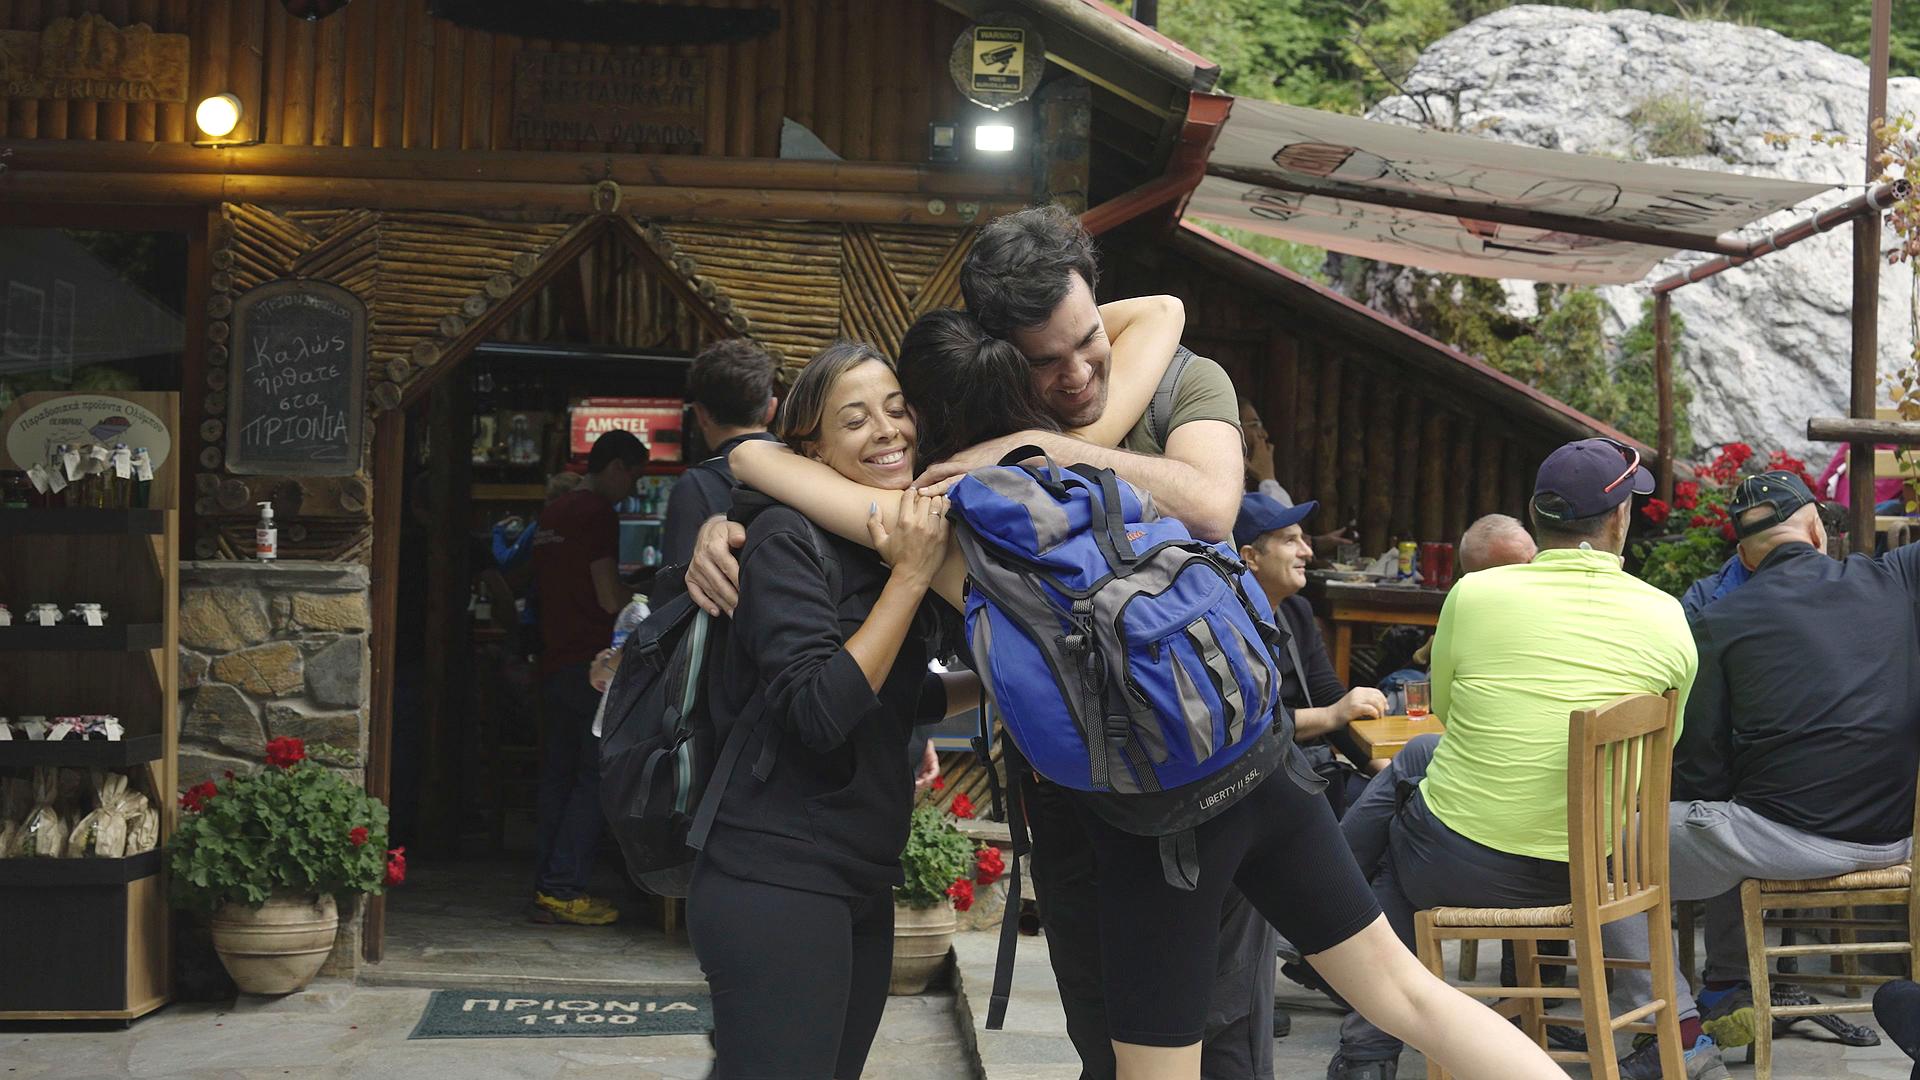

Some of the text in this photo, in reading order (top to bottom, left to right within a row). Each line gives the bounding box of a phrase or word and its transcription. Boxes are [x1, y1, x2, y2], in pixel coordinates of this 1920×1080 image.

[981, 31, 1019, 40] WARNING
[246, 335, 345, 372] Καλώς
[253, 365, 341, 395] ήρθατε
[279, 392, 325, 411] στα
[19, 402, 80, 431] Παραδοσιακά
[240, 405, 349, 446] ΠΡΙΟΝΙΑ
[585, 417, 649, 432] AMSTEL
[1199, 784, 1235, 809] LIBERTY
[1245, 768, 1260, 783] 55L
[461, 998, 698, 1012] ΠΡΙΟΝΙΑ
[517, 1013, 638, 1025] 1100
